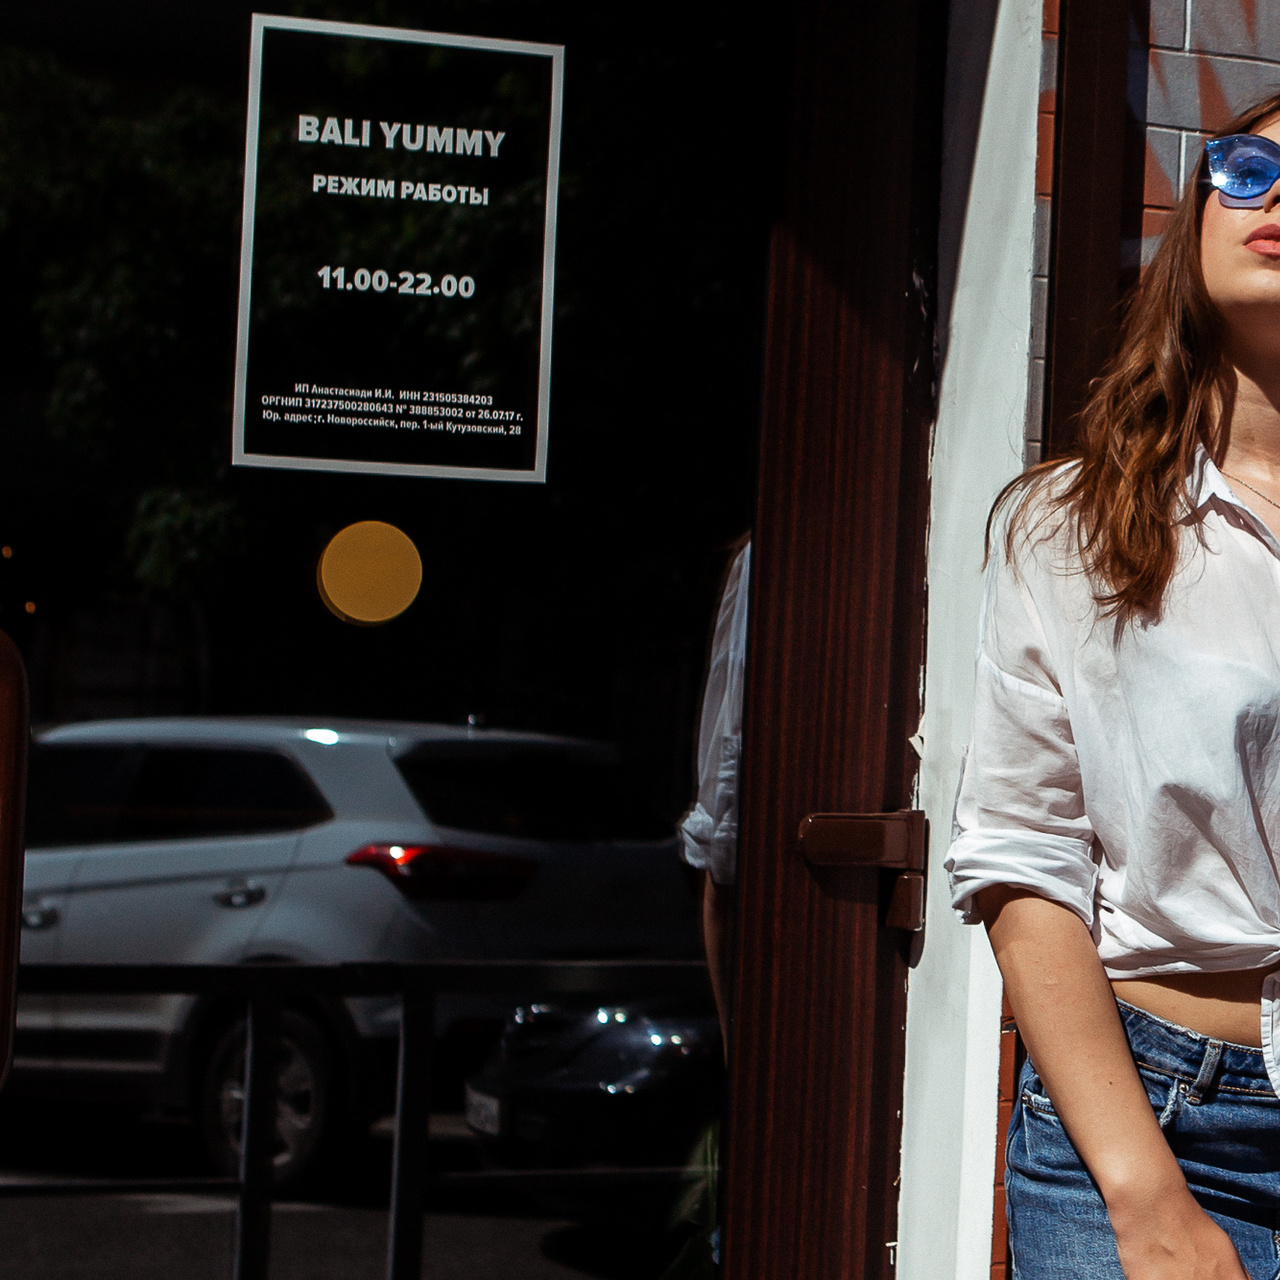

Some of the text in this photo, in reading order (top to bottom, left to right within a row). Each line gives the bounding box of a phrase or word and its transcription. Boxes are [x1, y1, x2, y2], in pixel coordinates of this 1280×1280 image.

[298, 114, 505, 157] BALI YUMMY
[313, 174, 488, 205] РЕЖИМ РАБОТЫ
[317, 266, 475, 298] 11.00-22.00
[295, 383, 309, 393] ИП
[311, 384, 372, 398] Анастасиади
[399, 390, 421, 400] ИНН
[262, 395, 302, 407] ОРГНИП
[465, 410, 476, 418] от
[516, 412, 523, 421] г.
[262, 410, 281, 422] Юр.
[327, 414, 398, 428] Новороссийск,
[400, 420, 420, 430] пер.
[446, 421, 507, 435] Кутузовский,
[509, 425, 521, 434] 28
